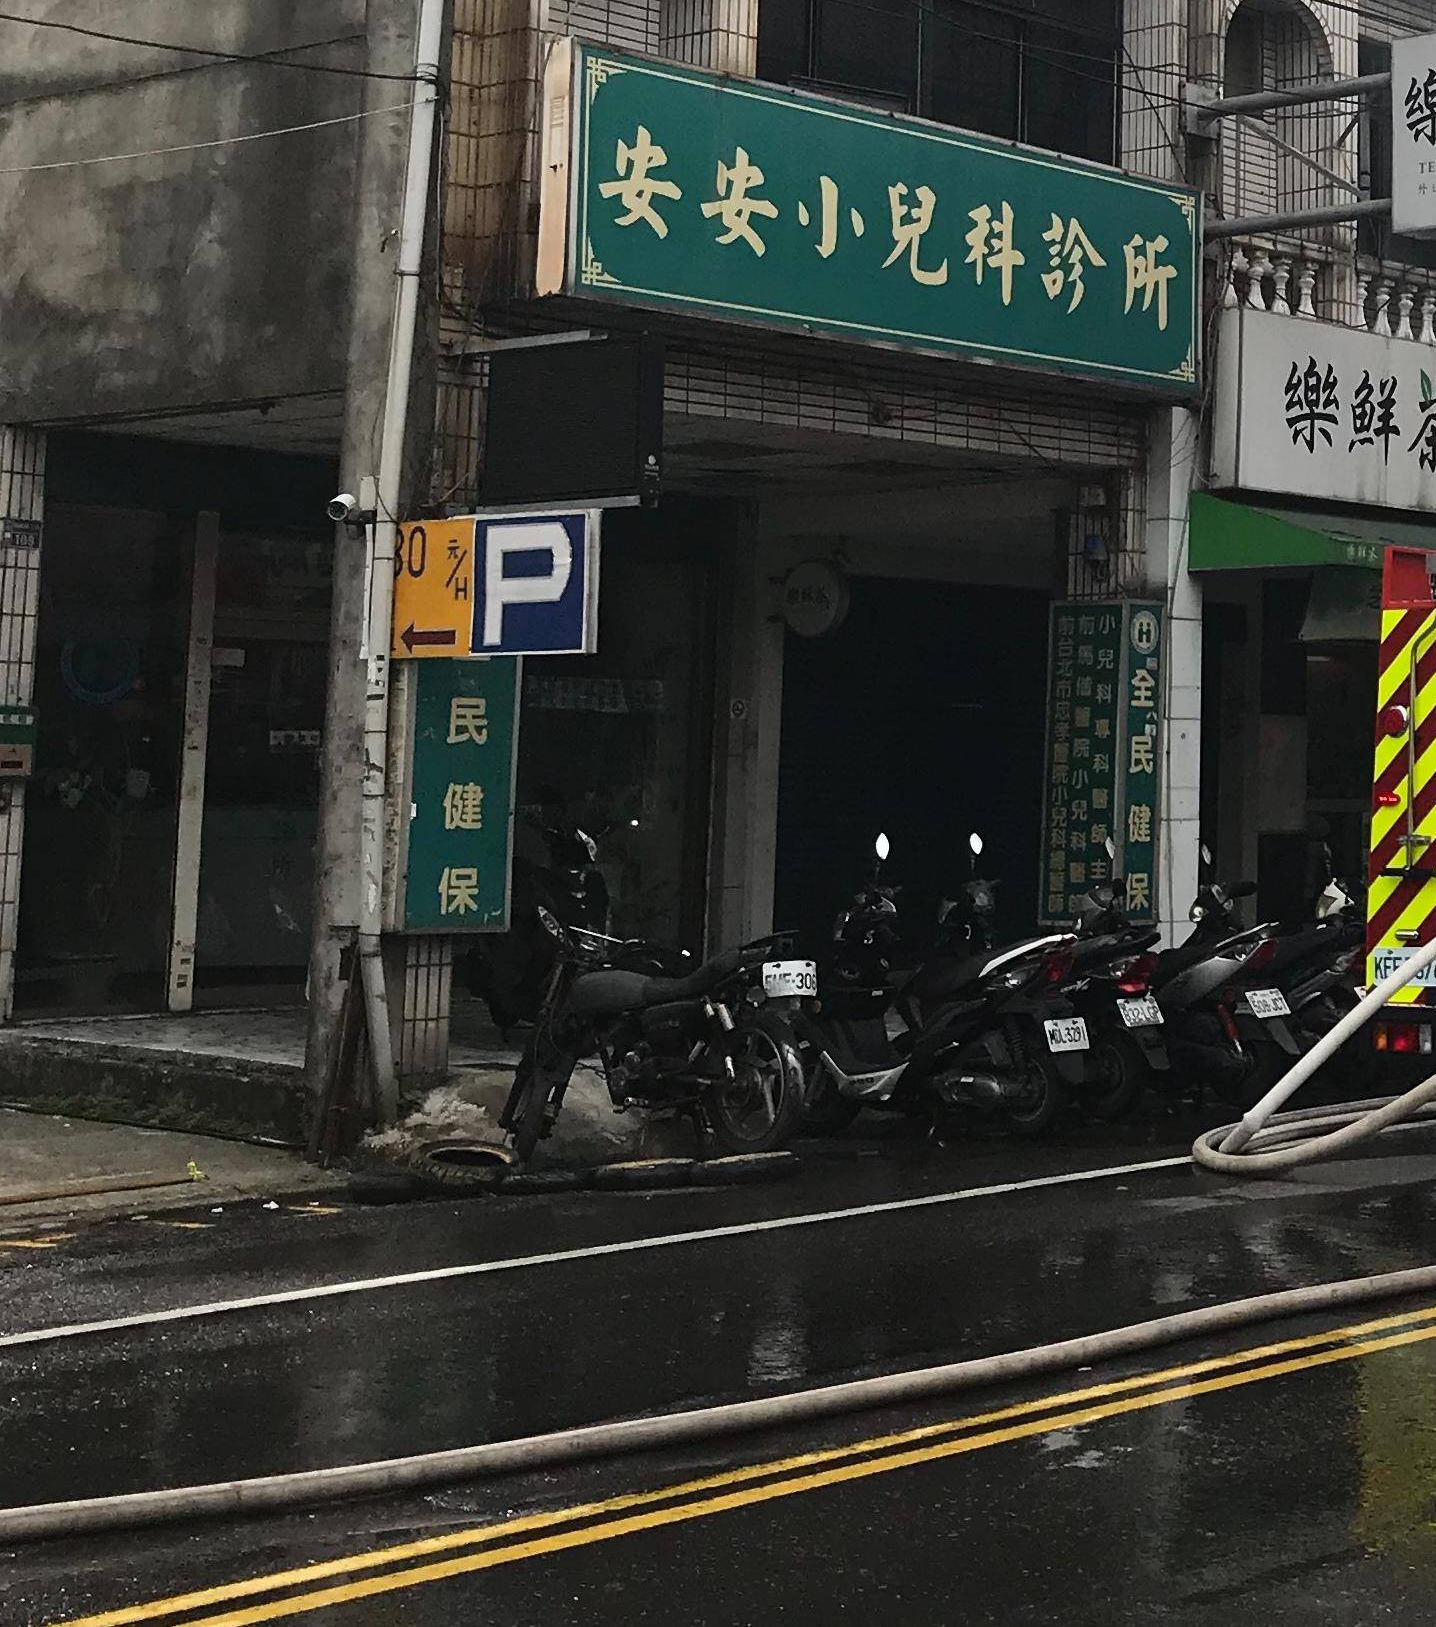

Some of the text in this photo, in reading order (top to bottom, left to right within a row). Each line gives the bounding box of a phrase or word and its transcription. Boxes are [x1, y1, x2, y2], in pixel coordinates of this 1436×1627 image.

[597, 124, 1179, 331] 安安小兒科診所
[482, 521, 573, 647] P
[1126, 668, 1156, 911] 全民健保
